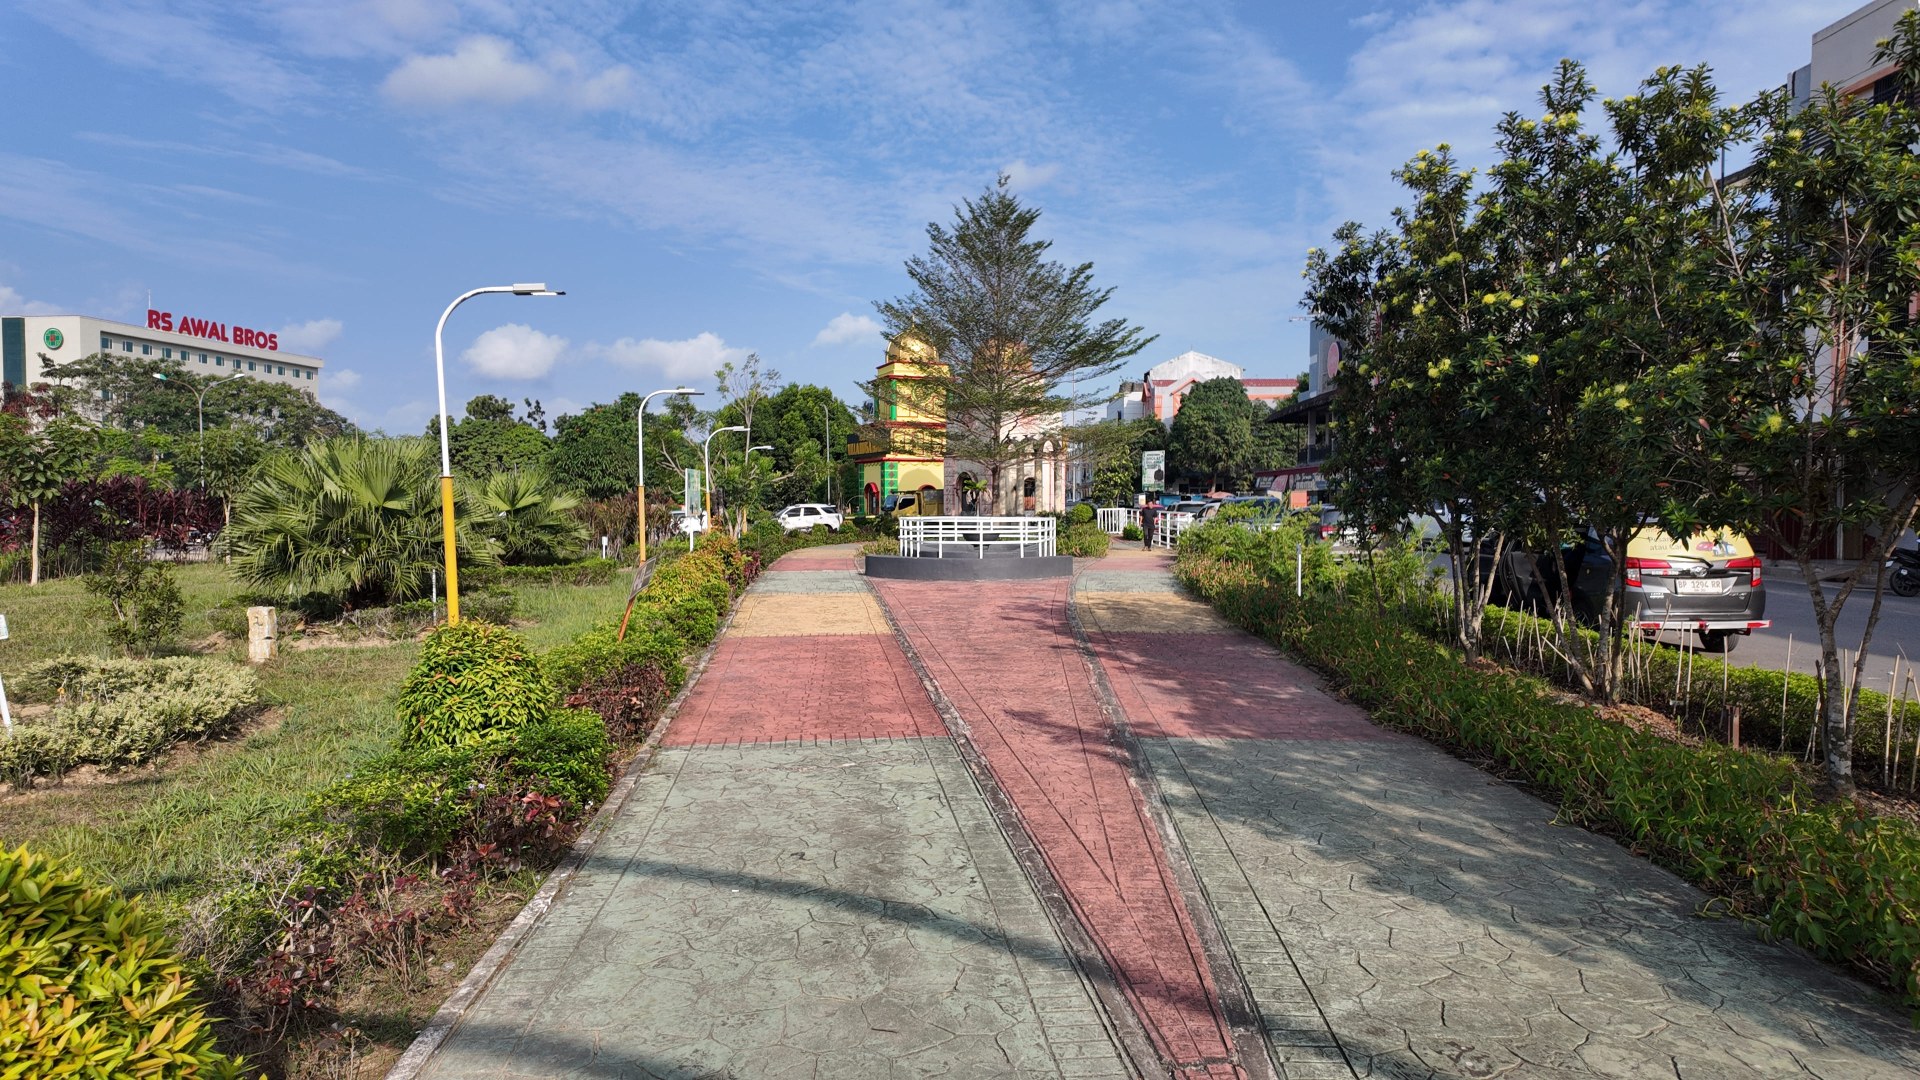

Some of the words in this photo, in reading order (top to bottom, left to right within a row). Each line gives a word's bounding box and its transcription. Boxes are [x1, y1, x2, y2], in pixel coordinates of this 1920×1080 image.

[147, 309, 173, 331] RS
[178, 316, 229, 342] AWAL
[233, 326, 278, 351] BROS
[1678, 579, 1688, 589] BP
[1691, 579, 1709, 589] 1294
[1711, 579, 1721, 588] RR
